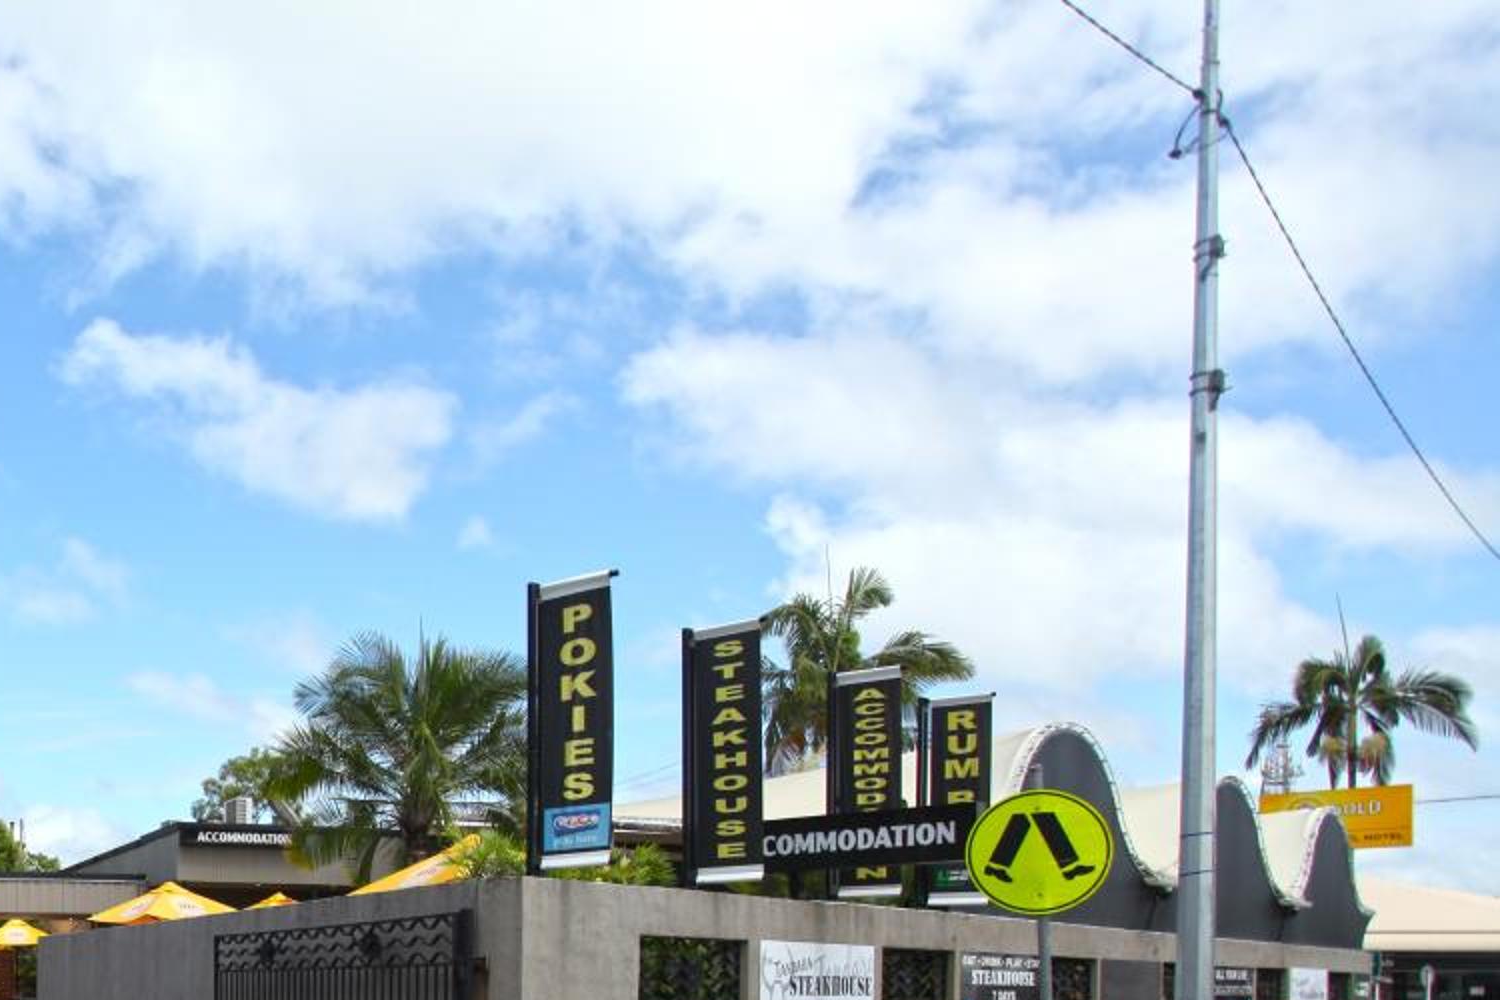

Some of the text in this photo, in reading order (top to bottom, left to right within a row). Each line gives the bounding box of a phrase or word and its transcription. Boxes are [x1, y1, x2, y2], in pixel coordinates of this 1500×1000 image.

[560, 603, 597, 801] POKIES
[711, 640, 748, 860] STEAKHOUSE
[197, 831, 293, 844] ACCOMMODATION
[763, 820, 956, 857] COMMODATION
[789, 975, 872, 997] STEAKHOUSE
[971, 969, 1036, 987] STEAKHOUSE
